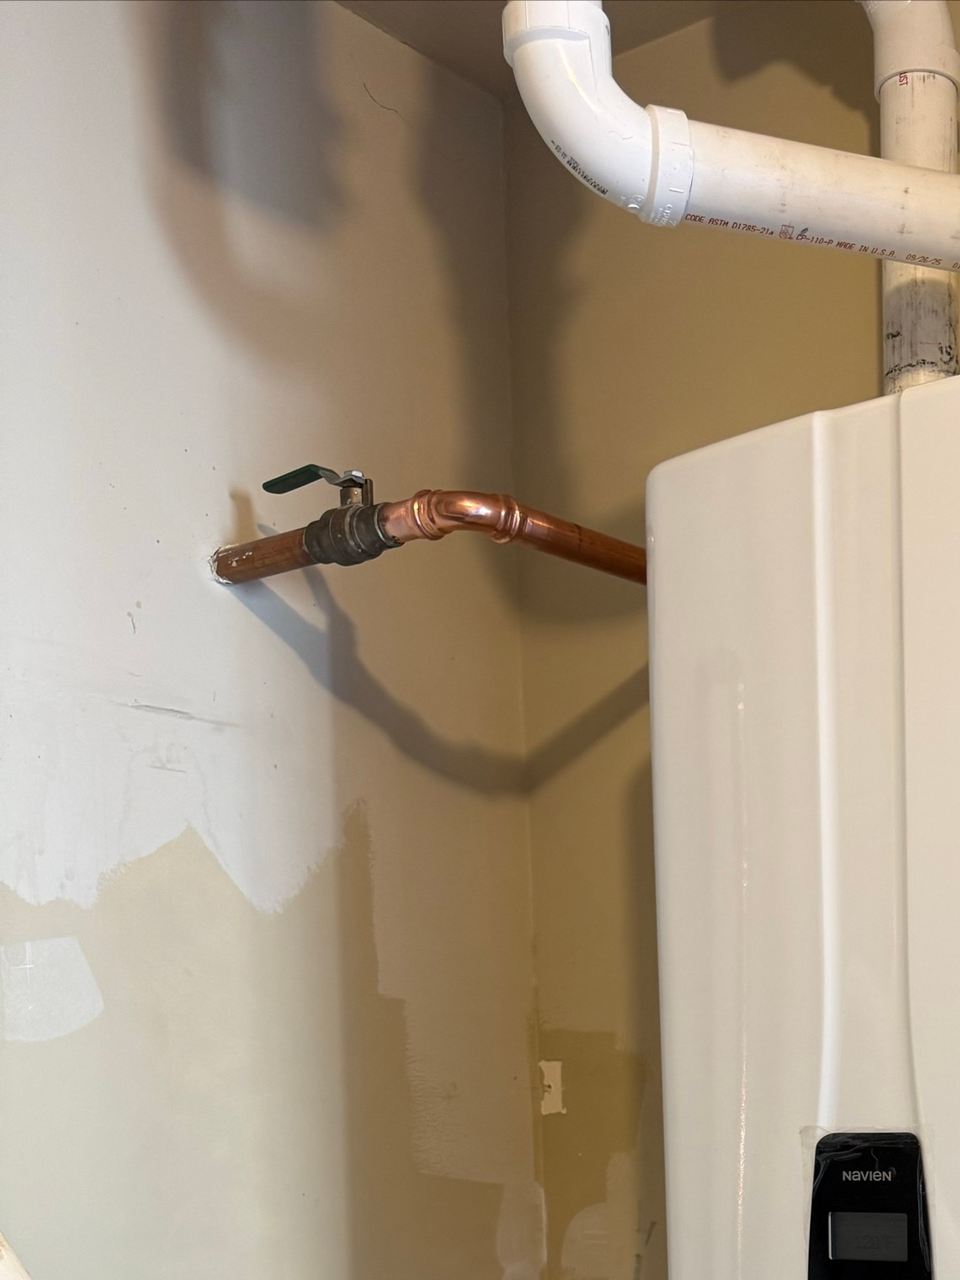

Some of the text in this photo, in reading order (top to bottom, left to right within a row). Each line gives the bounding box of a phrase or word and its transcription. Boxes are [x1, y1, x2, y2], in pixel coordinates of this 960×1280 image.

[684, 213, 706, 224] CODE
[708, 217, 729, 228] ASTM
[836, 241, 856, 251] MADE
[858, 244, 870, 253] IN
[905, 253, 943, 266] 09/26/25
